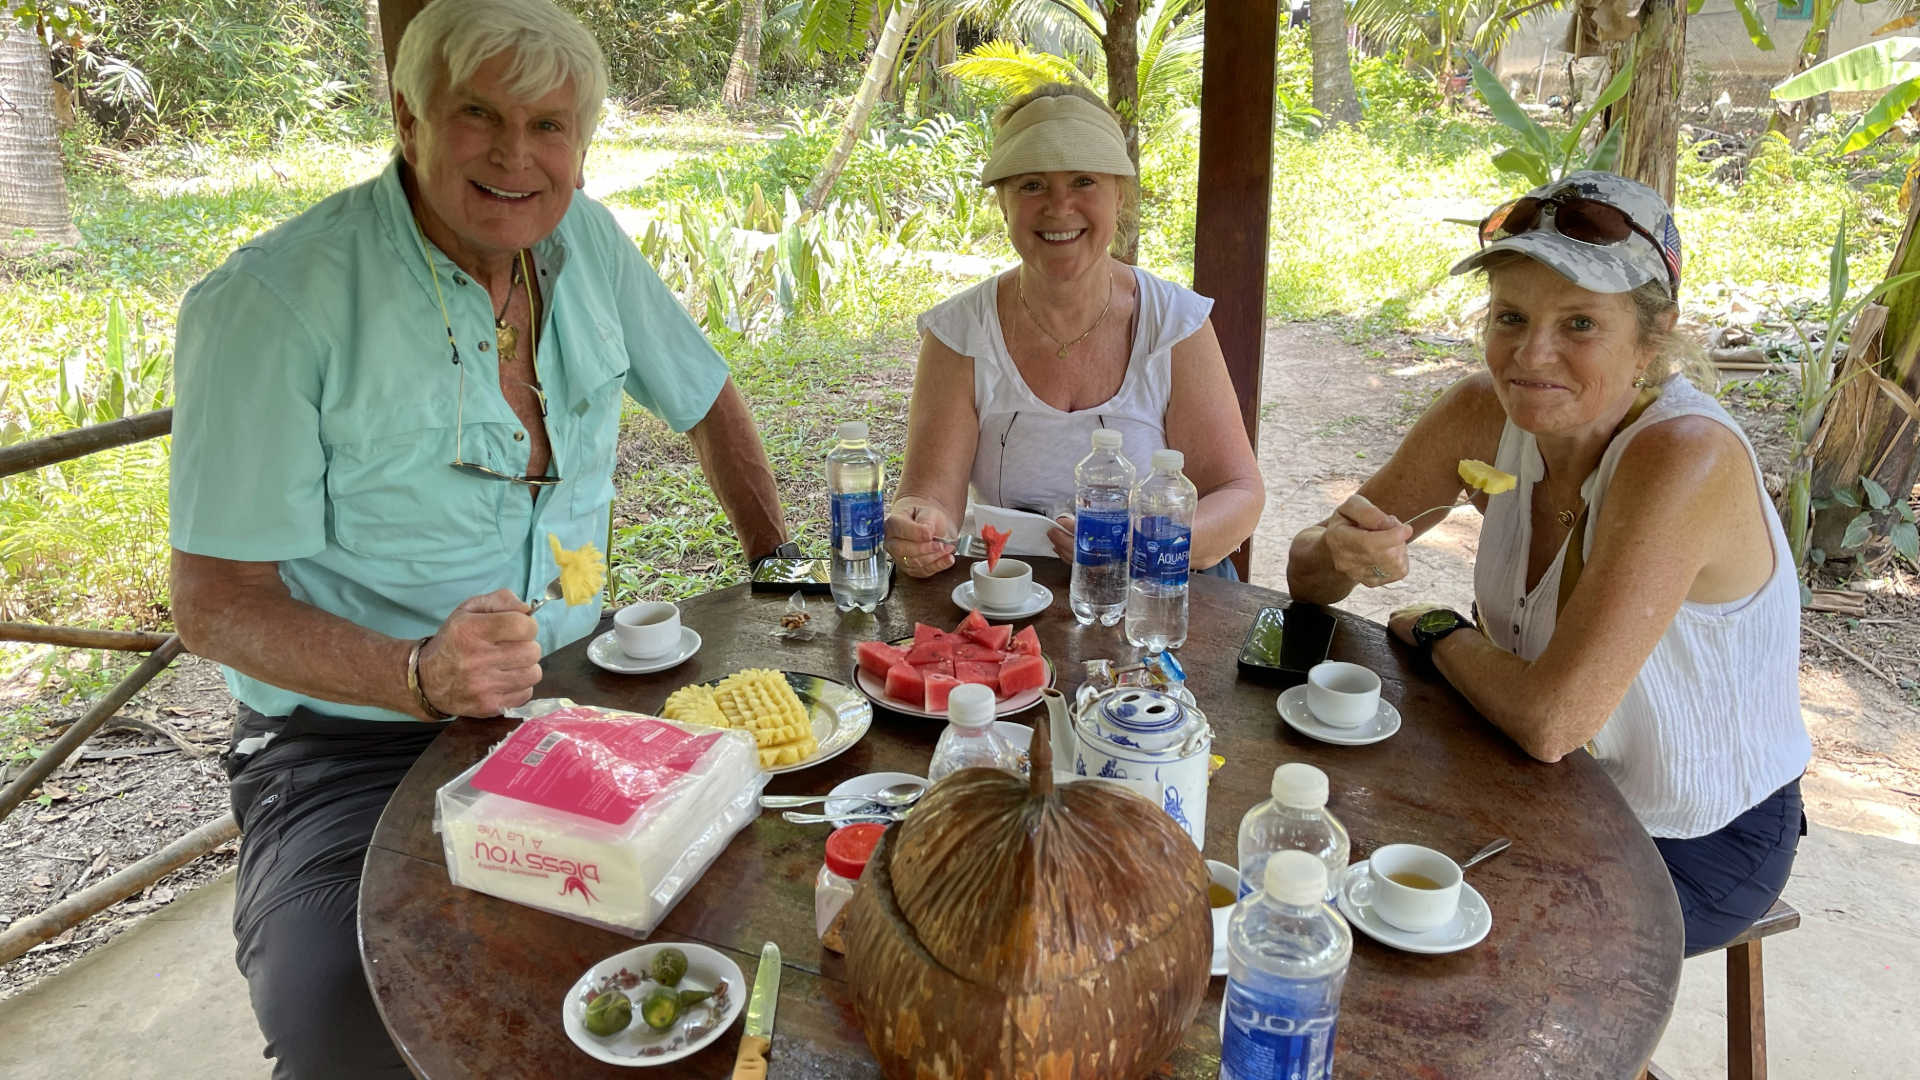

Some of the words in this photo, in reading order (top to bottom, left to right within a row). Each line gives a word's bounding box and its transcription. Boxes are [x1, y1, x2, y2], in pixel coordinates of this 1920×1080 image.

[477, 825, 501, 841] Vie
[506, 832, 524, 846] La
[477, 862, 508, 873] quality
[508, 868, 549, 879] premium
